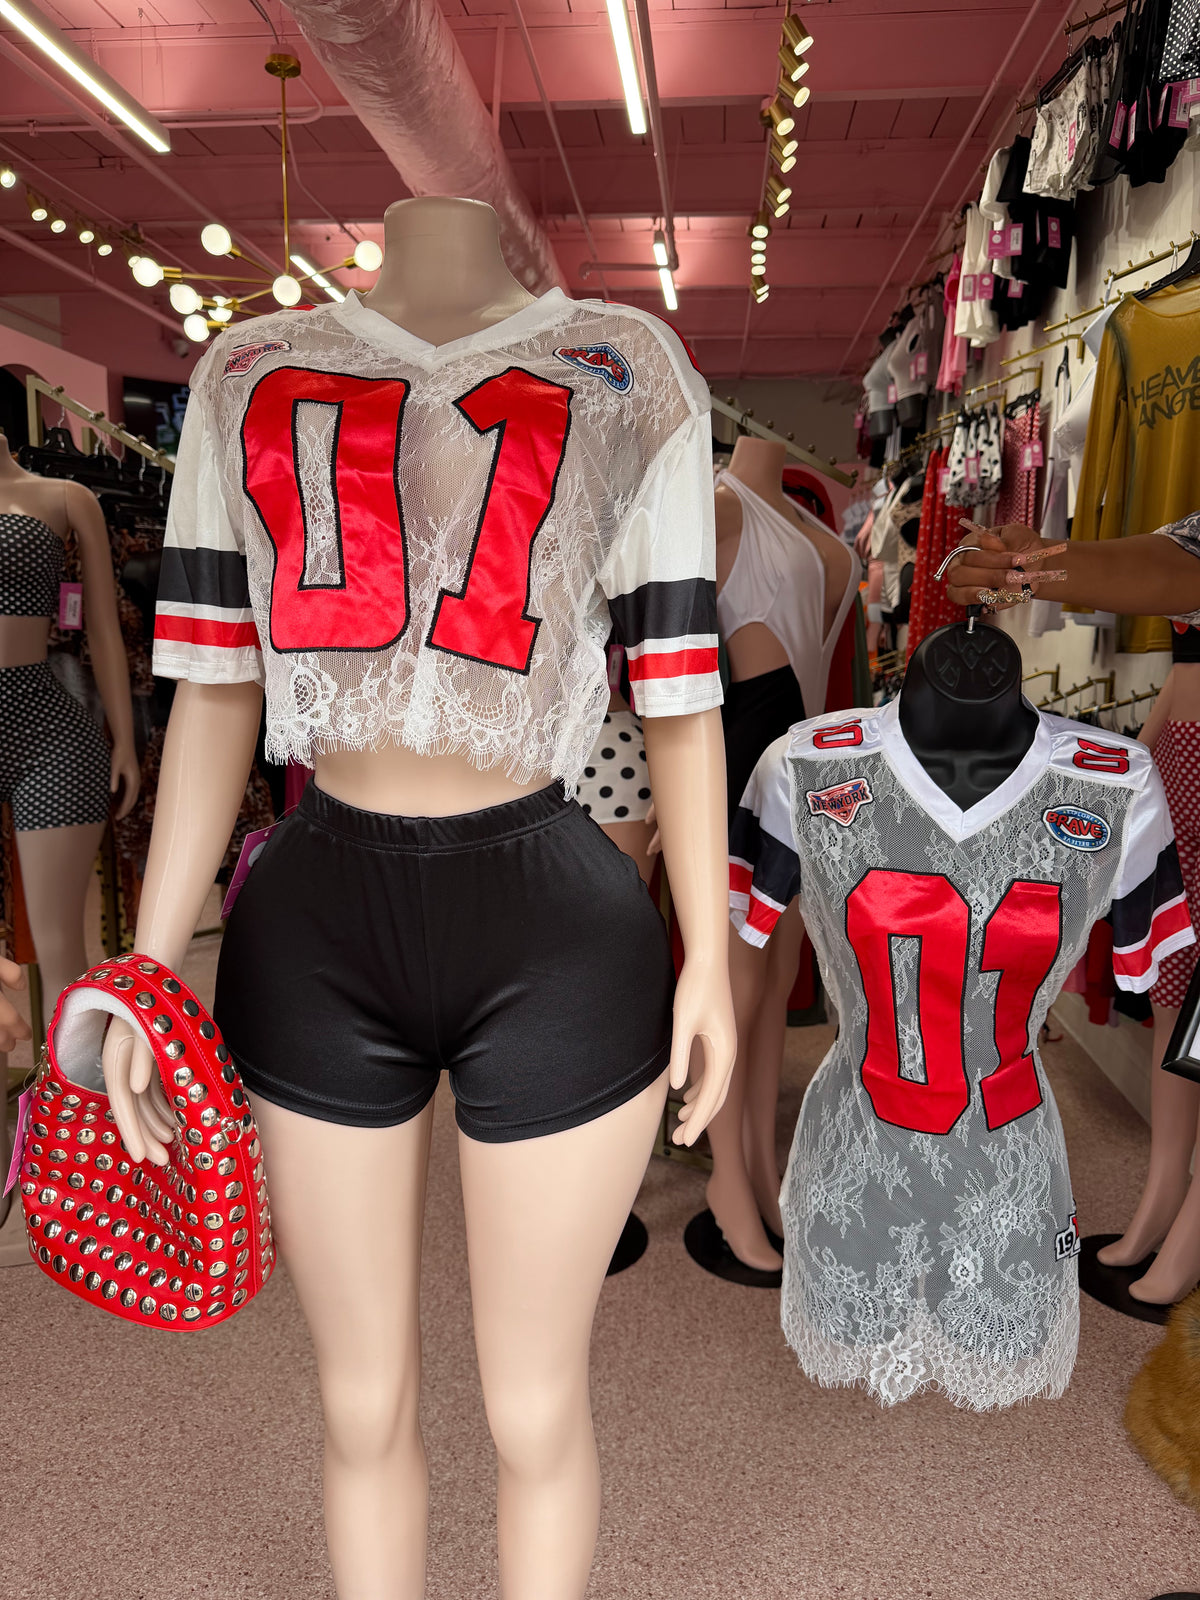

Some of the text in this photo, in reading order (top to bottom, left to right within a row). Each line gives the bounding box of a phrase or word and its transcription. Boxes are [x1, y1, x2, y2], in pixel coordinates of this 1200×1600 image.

[224, 344, 286, 373] EWYORK
[558, 348, 625, 382] BRAVE
[240, 365, 574, 676] 01
[1045, 811, 1103, 839] BRAVE
[845, 867, 1062, 1135] 01
